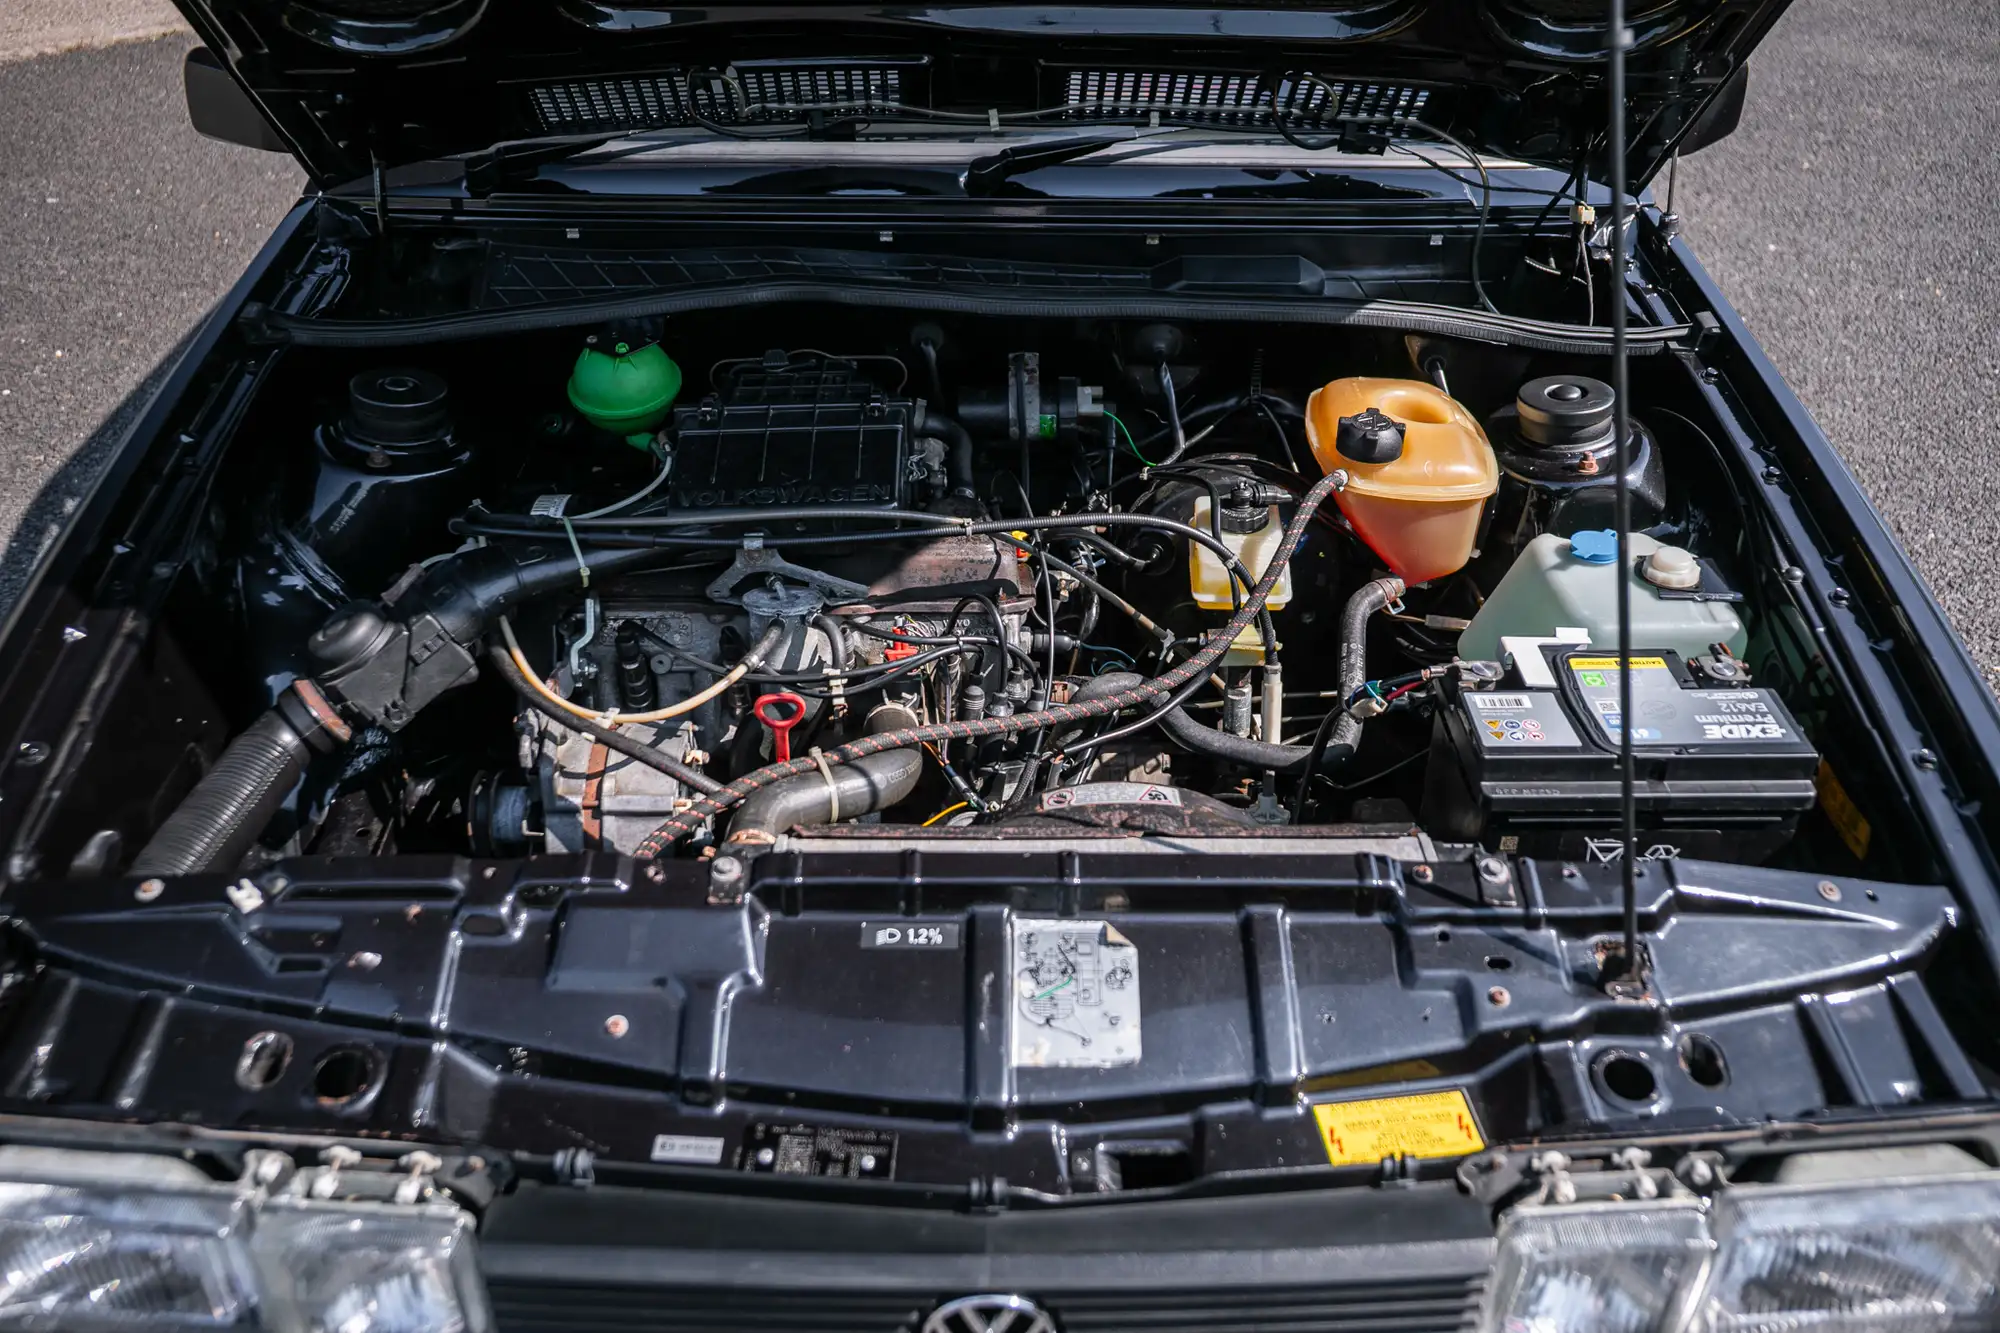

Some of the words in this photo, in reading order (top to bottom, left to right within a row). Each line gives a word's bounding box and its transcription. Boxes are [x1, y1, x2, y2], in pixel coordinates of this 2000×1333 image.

[677, 484, 890, 507] VOLKSWAGEN
[1717, 701, 1769, 713] EA612
[1694, 714, 1776, 724] Premium
[1703, 724, 1786, 739] EXIDE
